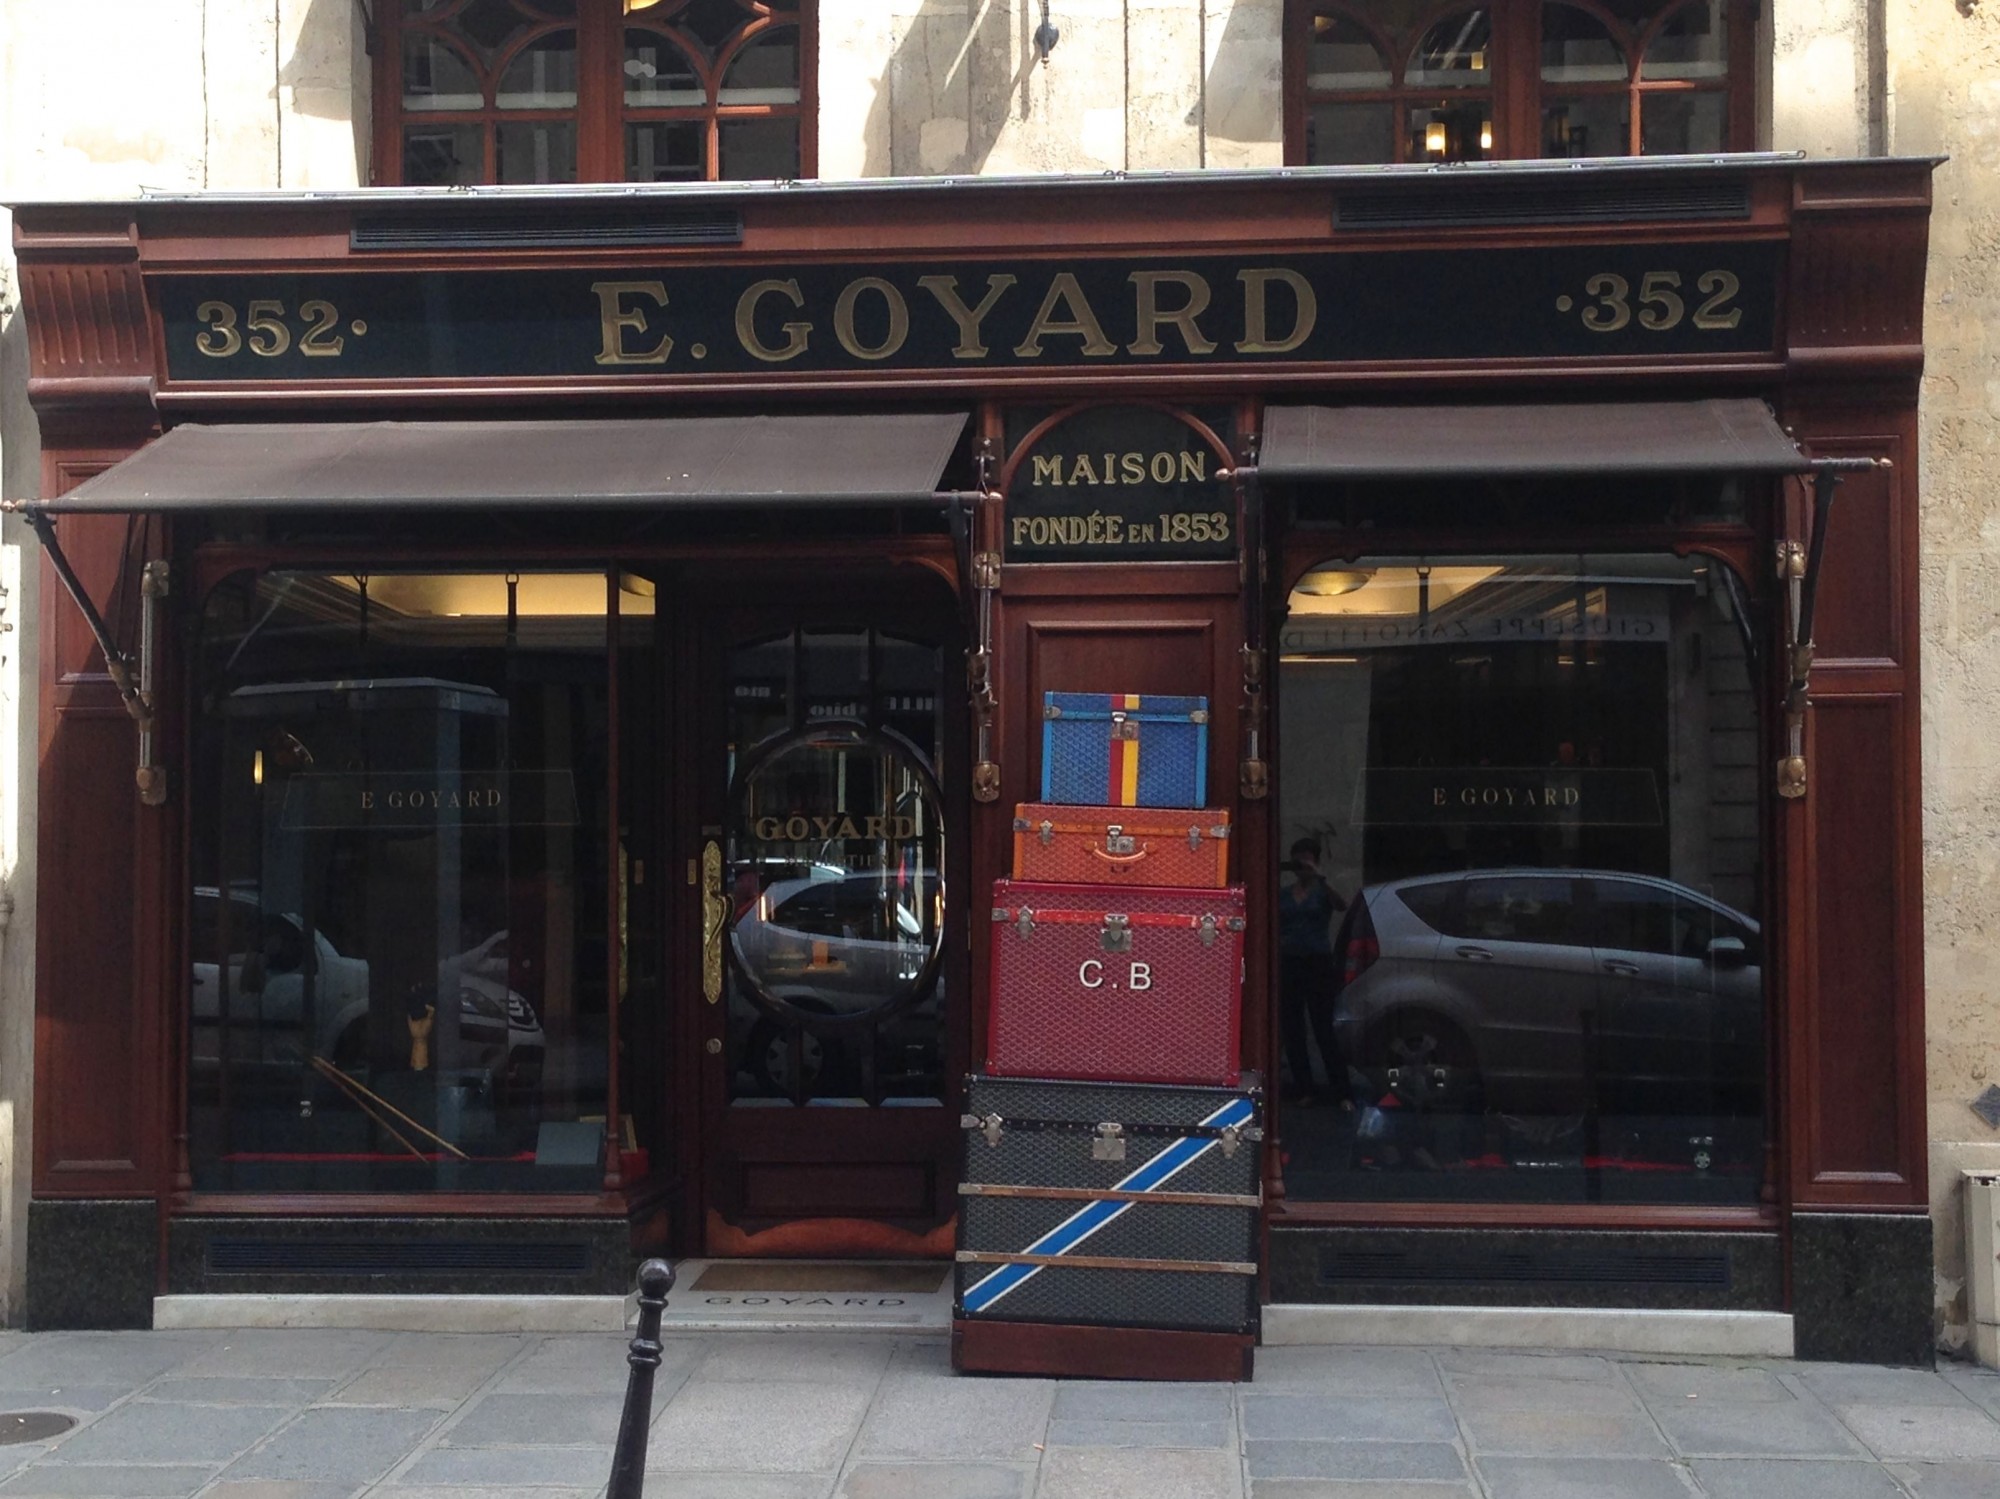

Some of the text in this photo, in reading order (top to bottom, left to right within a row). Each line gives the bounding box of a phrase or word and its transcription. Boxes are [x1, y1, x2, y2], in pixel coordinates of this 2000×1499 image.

[590, 267, 1318, 366] E. GOYARD
[1032, 451, 1205, 486] MAISON
[1012, 509, 1230, 545] FONDÉE EN 1853
[360, 789, 502, 809] E GOYARD
[1433, 787, 1580, 806] E GOYARD
[755, 815, 918, 842] GOYARD
[705, 1297, 905, 1306] GOYARD
